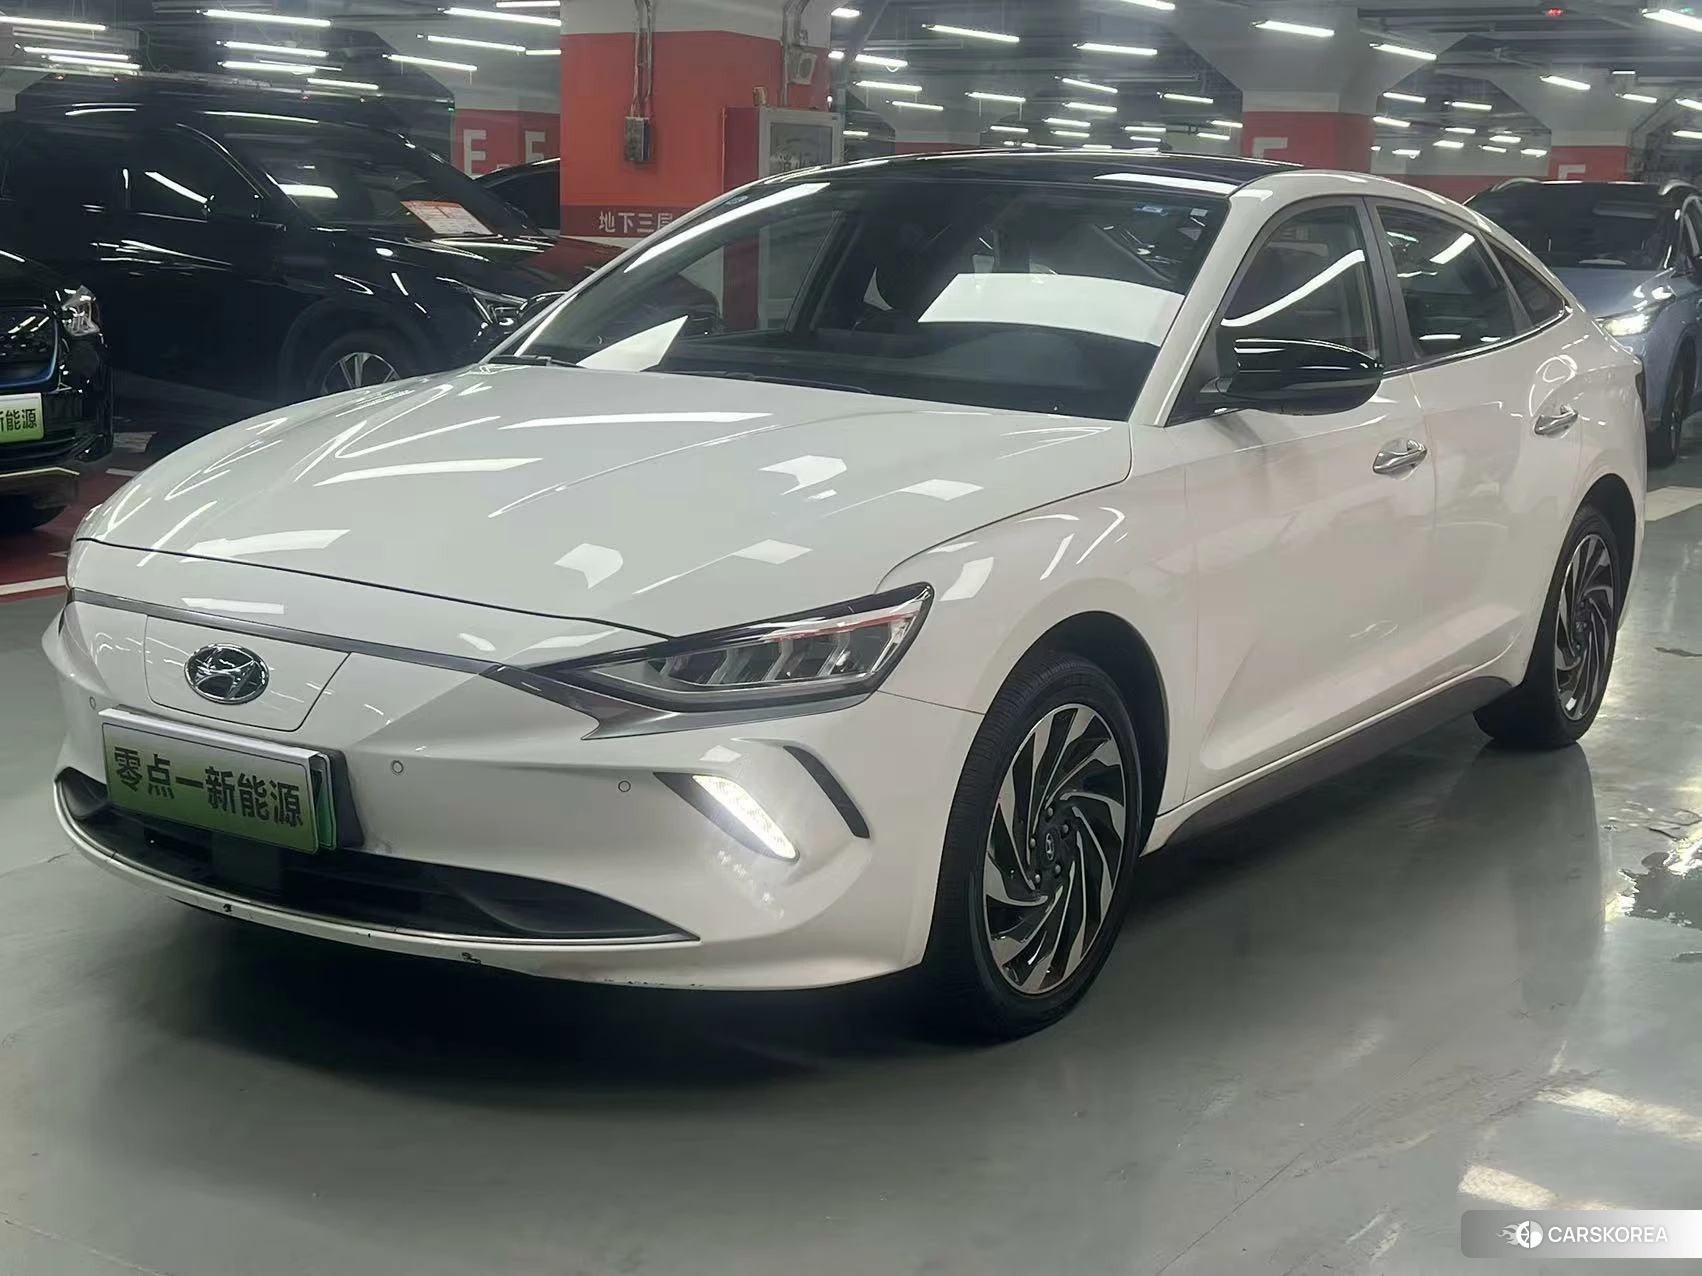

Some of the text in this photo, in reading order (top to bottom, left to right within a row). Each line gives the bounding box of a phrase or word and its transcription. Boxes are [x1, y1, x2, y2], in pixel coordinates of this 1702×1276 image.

[0, 408, 37, 432] 能源
[113, 746, 304, 827] 零点一新能源
